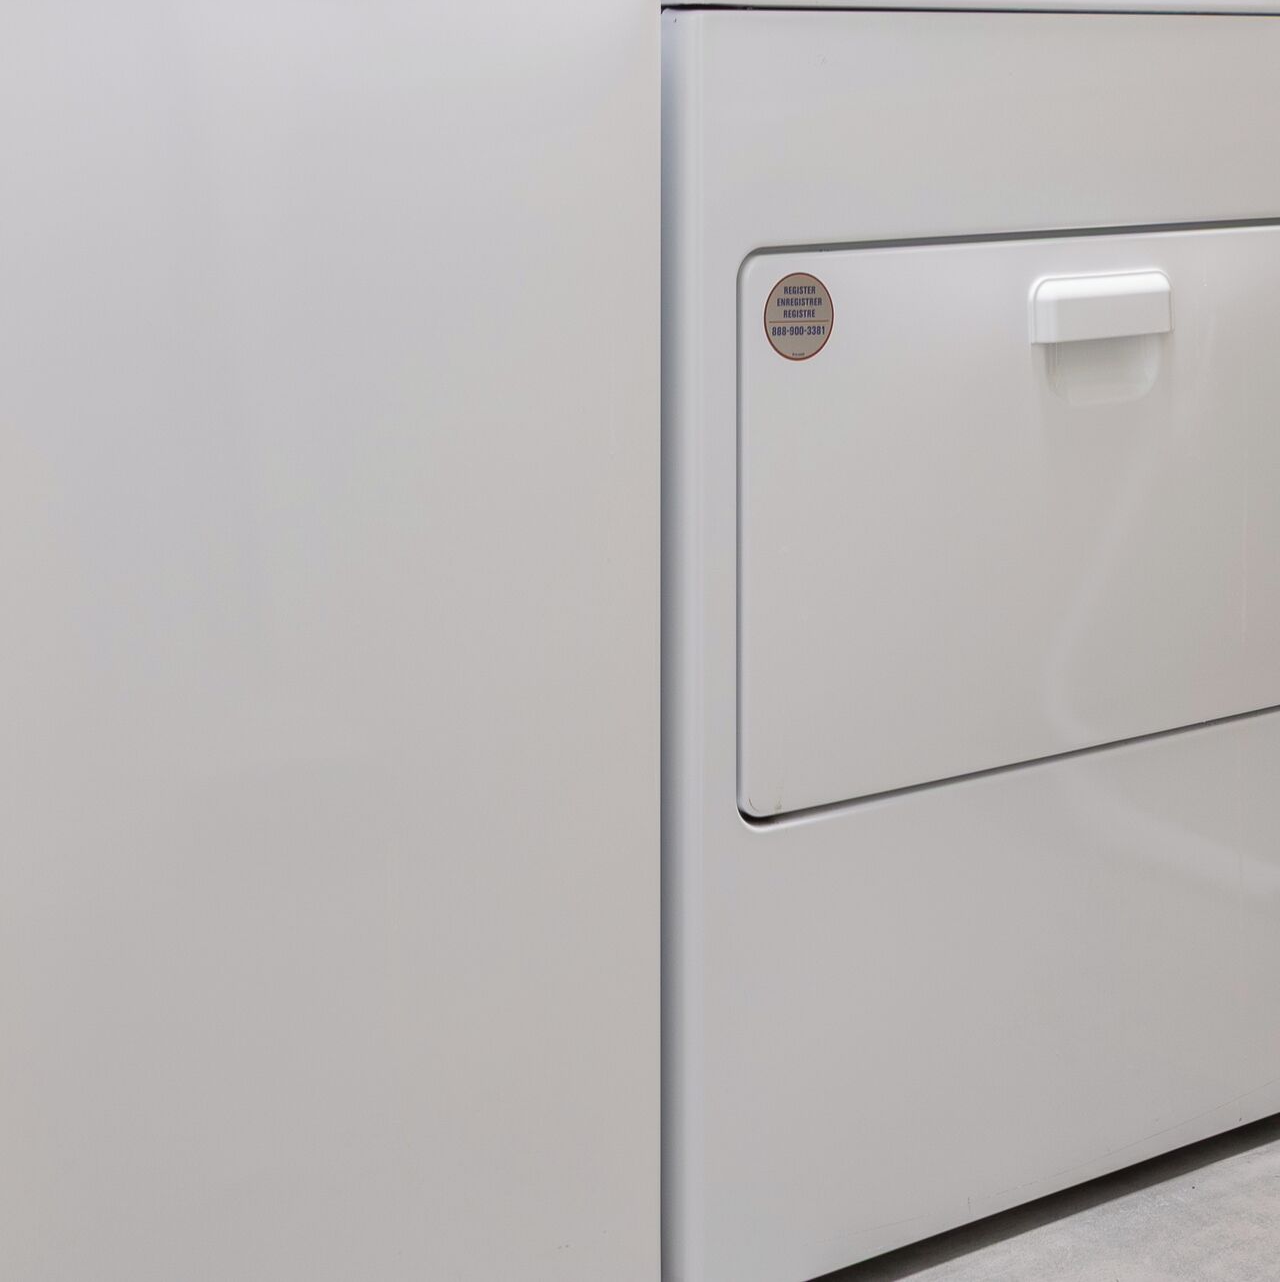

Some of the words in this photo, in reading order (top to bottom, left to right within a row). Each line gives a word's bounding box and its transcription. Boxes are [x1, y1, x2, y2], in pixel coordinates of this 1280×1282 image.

[783, 286, 816, 295] REGISTER
[777, 297, 822, 307] ENREGISTRER
[783, 309, 815, 319] REGISTRE
[771, 325, 825, 336] 888-900-3381
